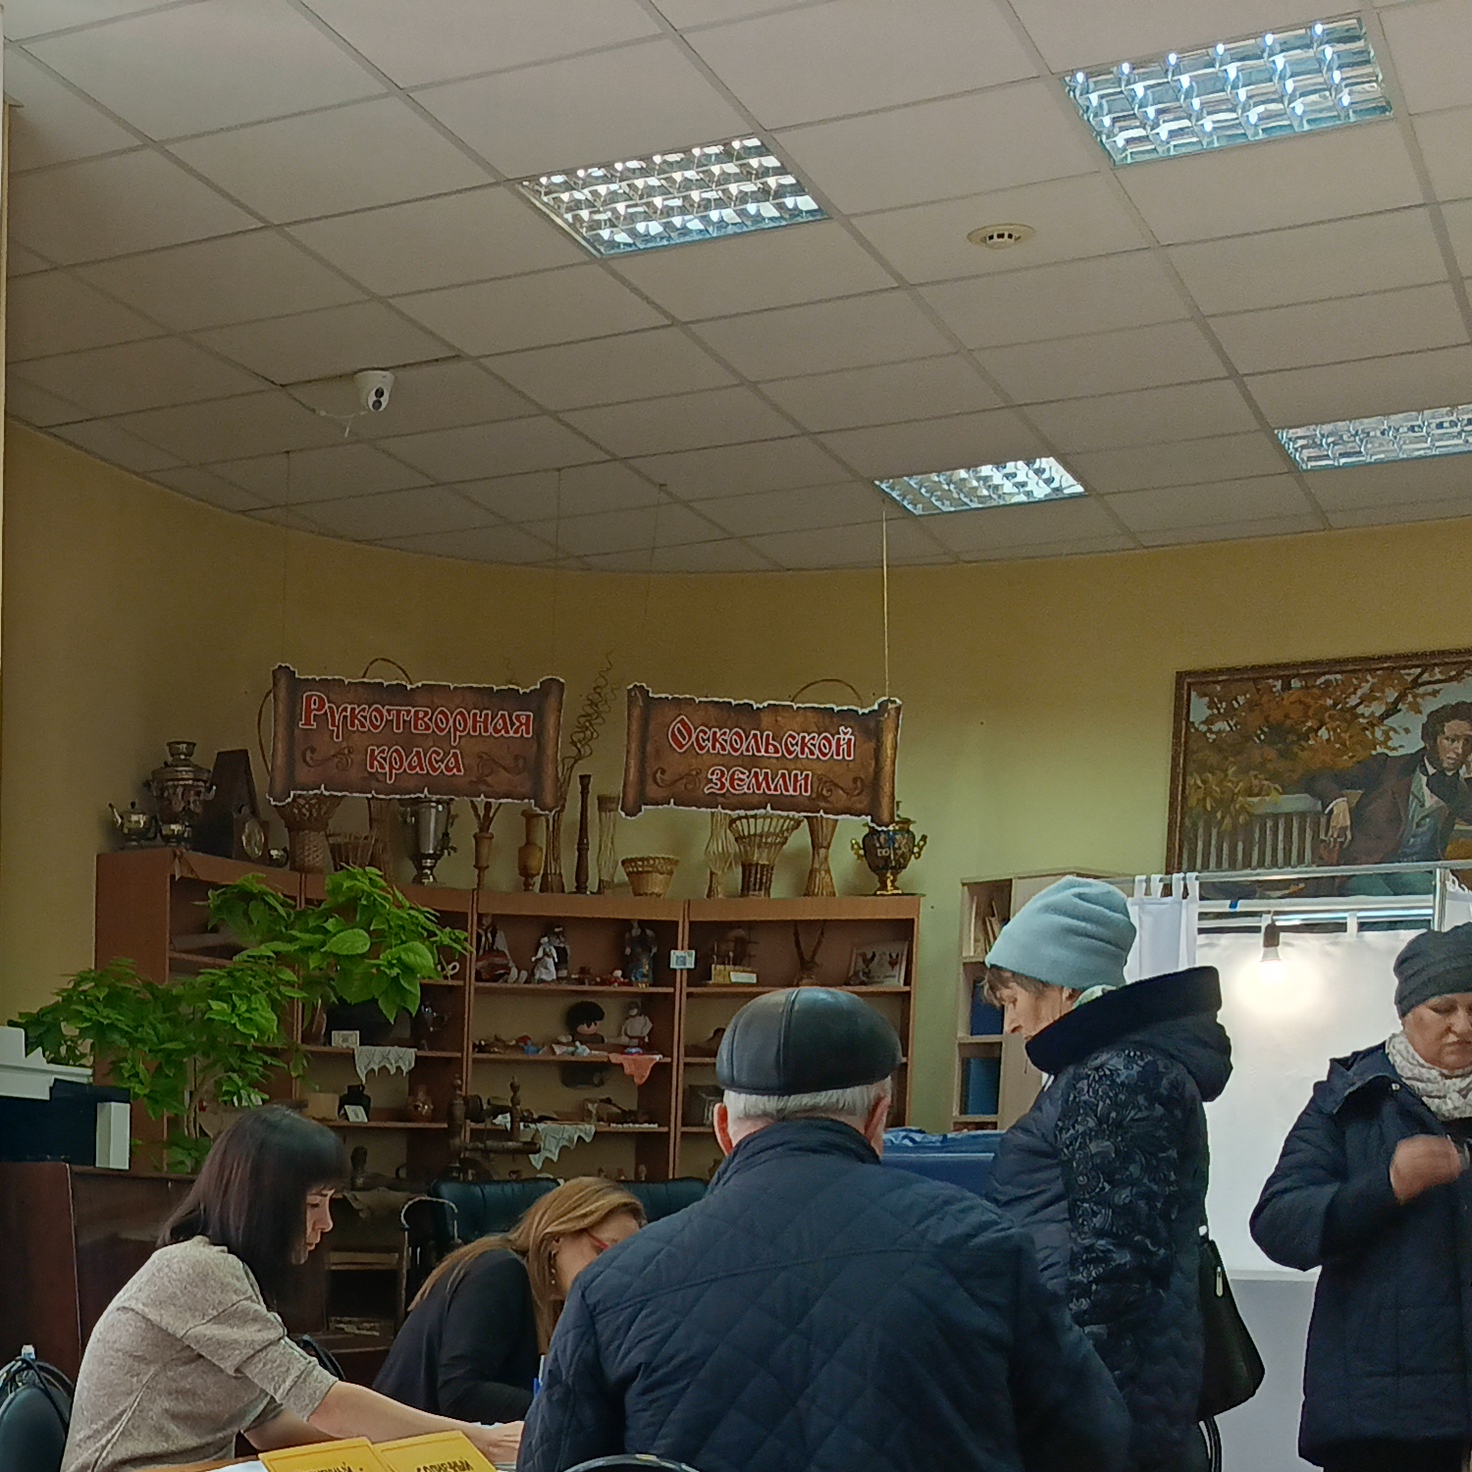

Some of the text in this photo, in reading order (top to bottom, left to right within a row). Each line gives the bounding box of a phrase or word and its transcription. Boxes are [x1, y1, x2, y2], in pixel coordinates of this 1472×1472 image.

[299, 692, 533, 745] Рукотворная
[668, 714, 854, 760] Оскольской
[367, 746, 464, 784] краса
[704, 766, 811, 796] земли
